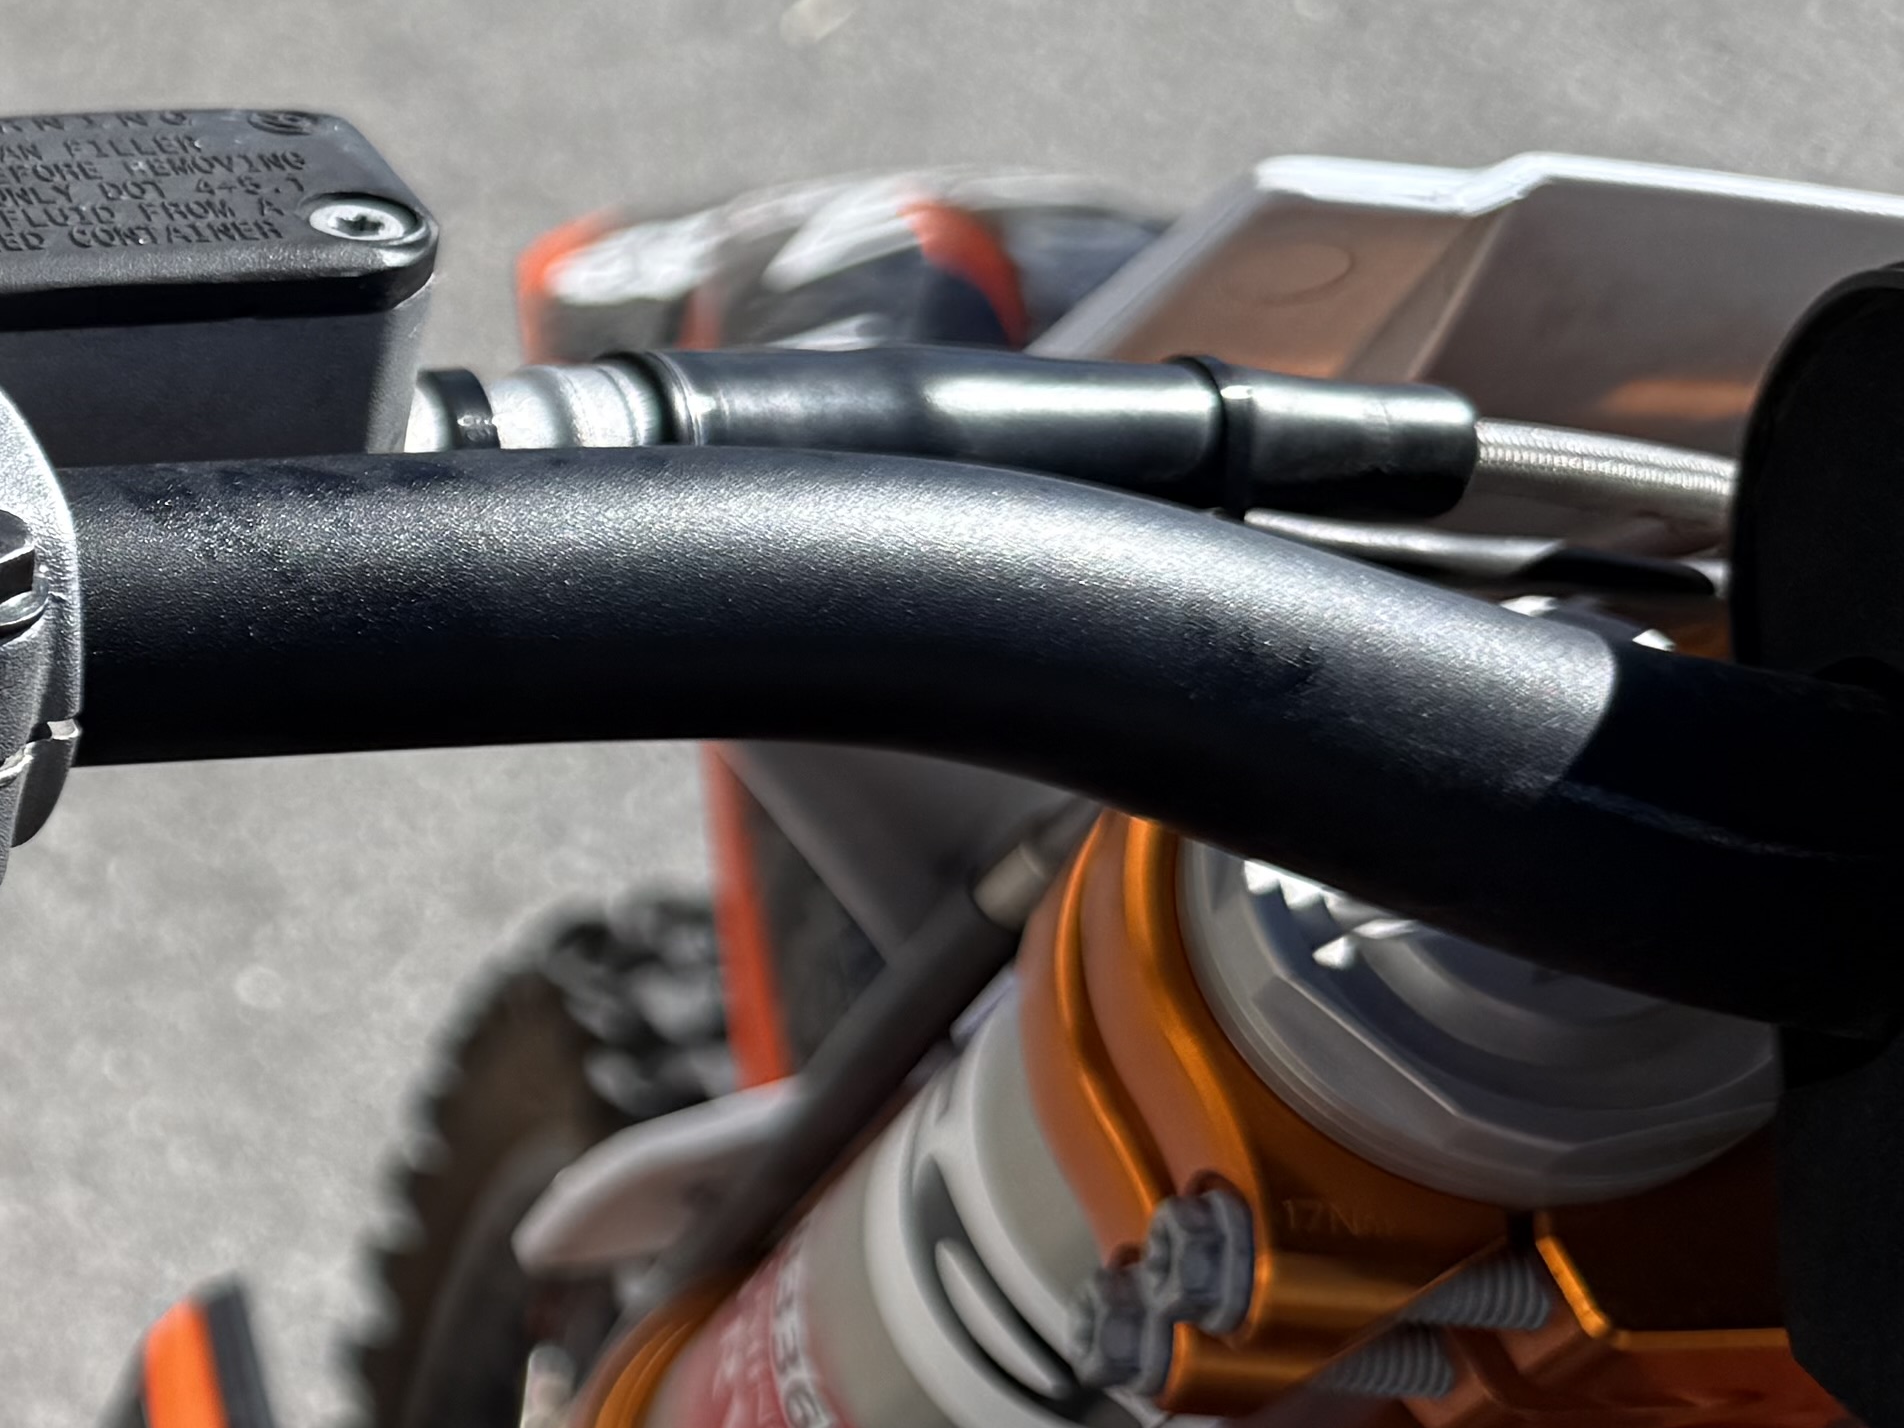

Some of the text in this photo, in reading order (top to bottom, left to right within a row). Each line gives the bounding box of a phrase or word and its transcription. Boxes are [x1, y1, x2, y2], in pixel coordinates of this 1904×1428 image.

[63, 134, 202, 159] FILLER
[121, 150, 307, 178] REMOVING
[97, 179, 166, 202] DOT
[138, 199, 236, 223] FROM
[257, 196, 286, 218] A
[68, 220, 285, 250] CONTAINER
